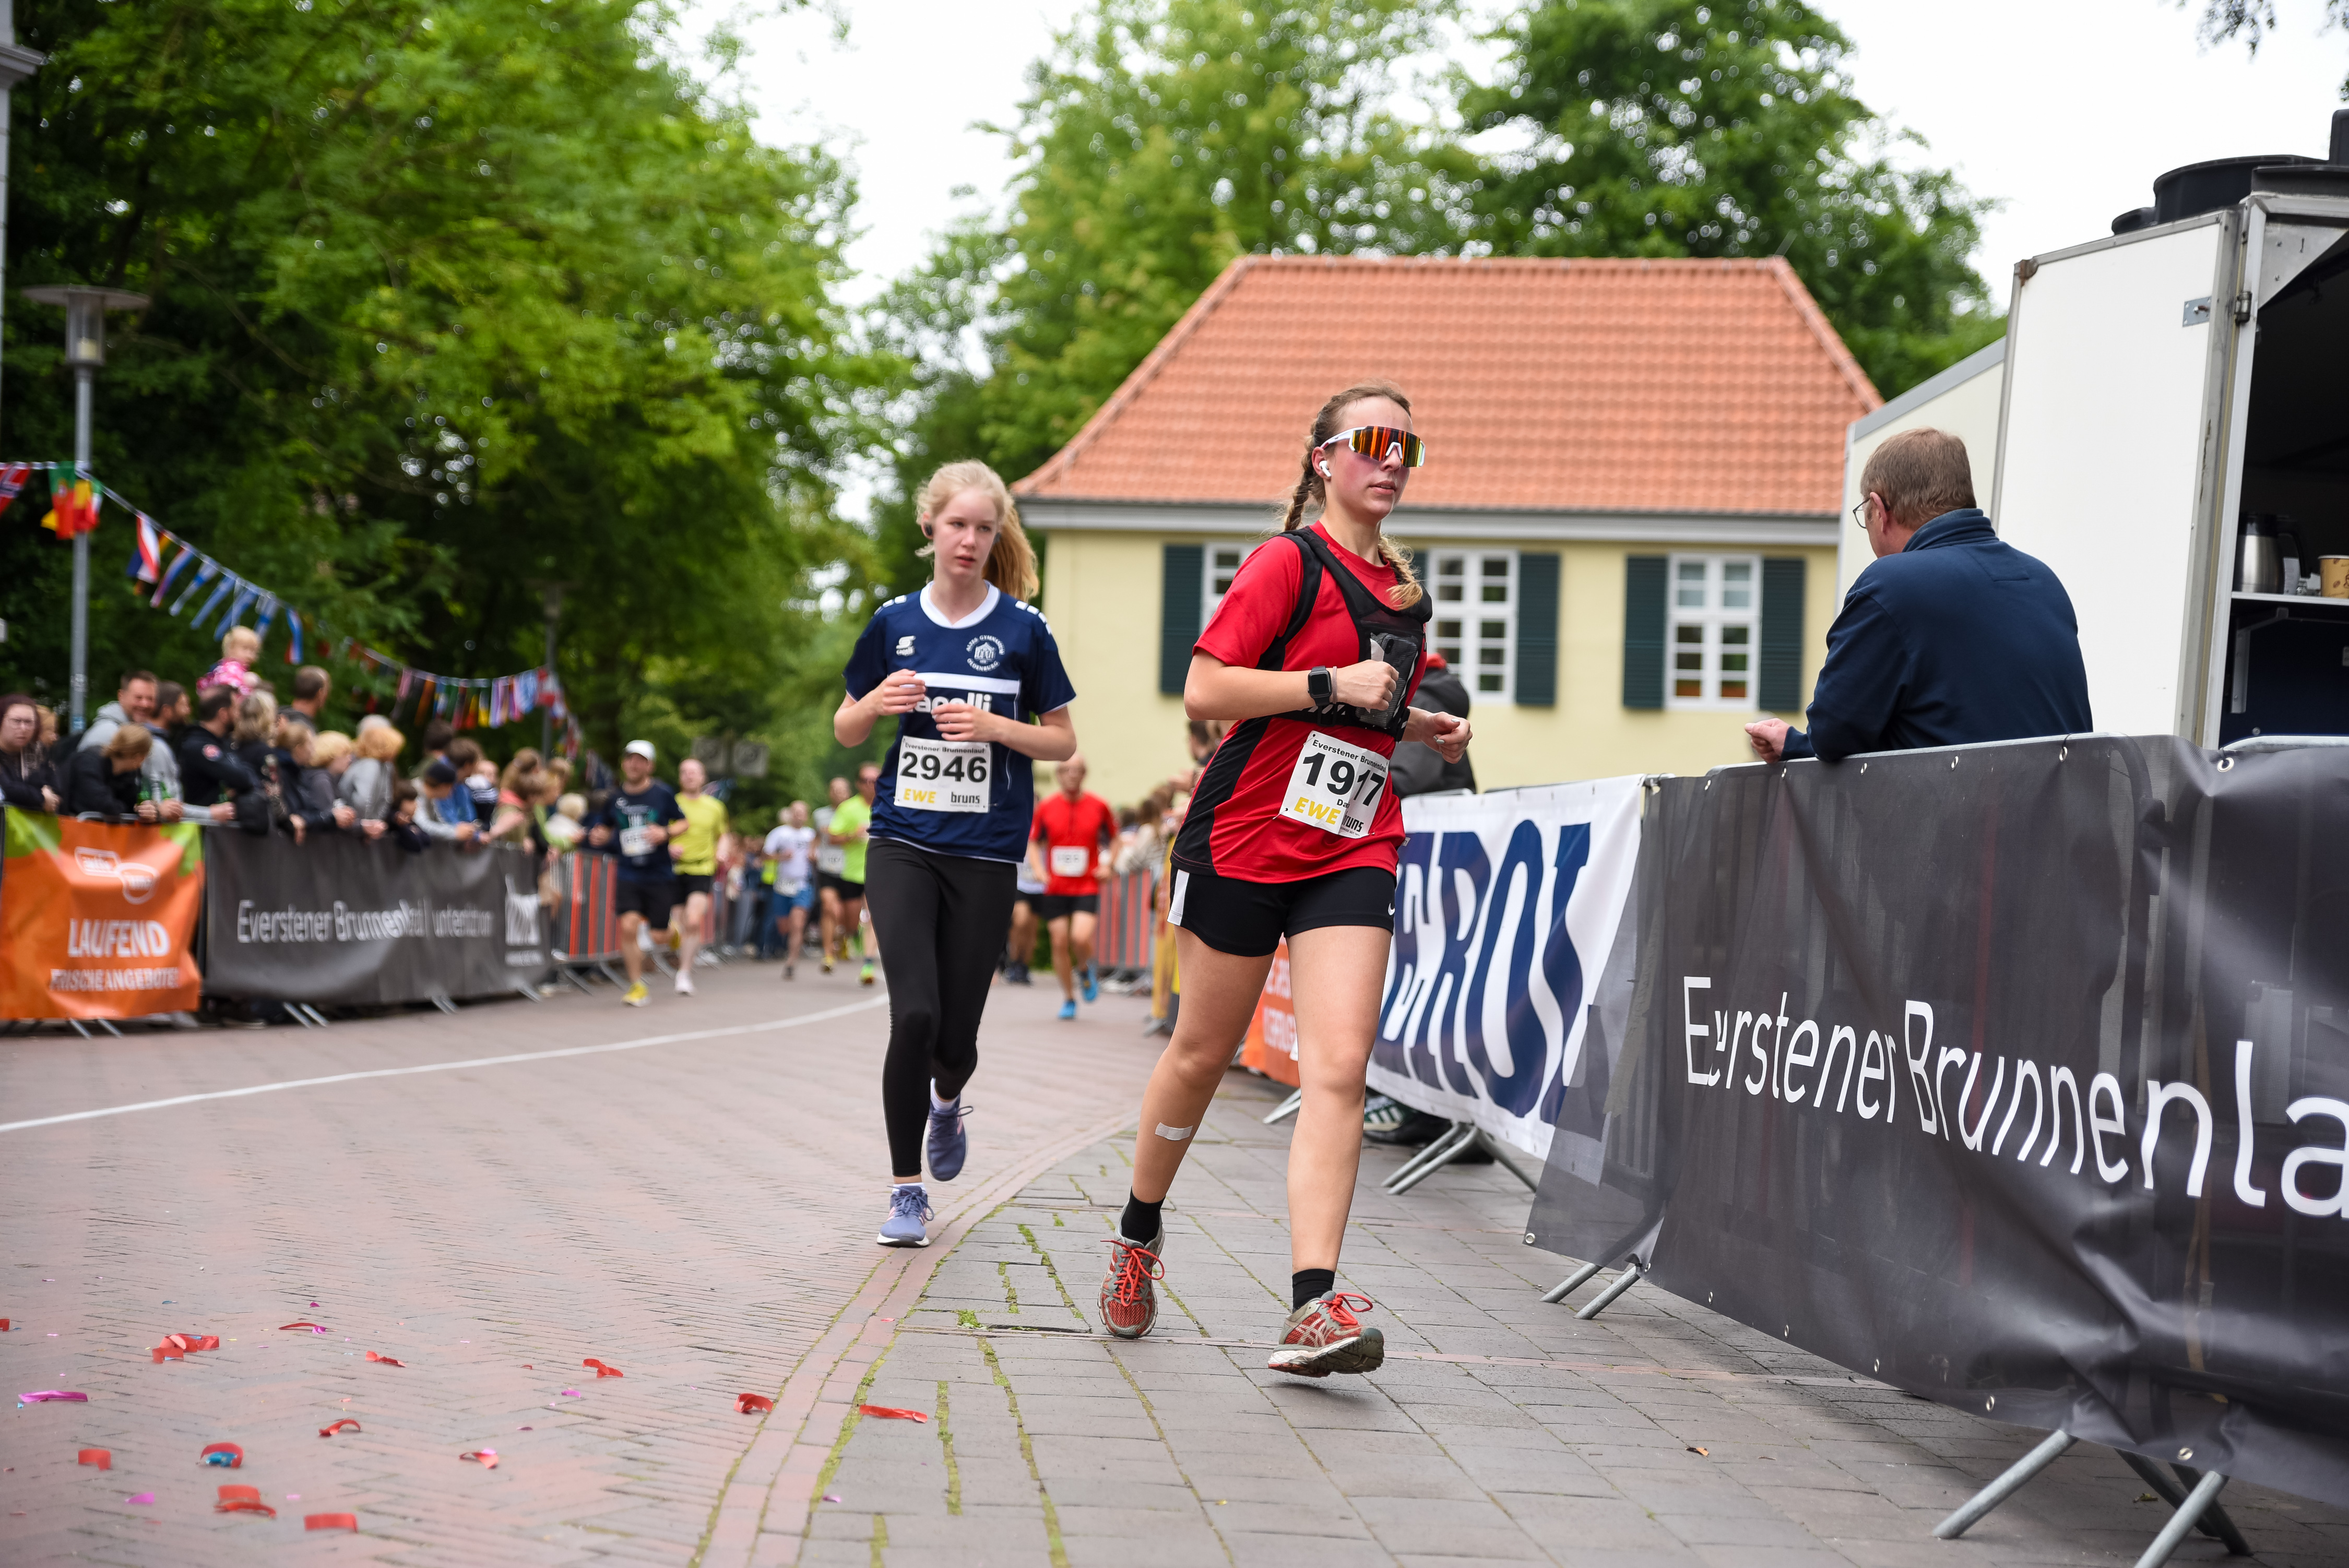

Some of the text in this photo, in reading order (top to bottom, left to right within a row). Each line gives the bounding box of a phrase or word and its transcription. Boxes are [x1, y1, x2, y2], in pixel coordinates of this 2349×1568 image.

[967, 658, 1000, 672] OLDENBURG
[905, 743, 940, 752] Everstener
[1312, 739, 1359, 761] Everstener
[899, 751, 987, 783] 2946
[1302, 752, 1385, 806] 1917
[903, 788, 980, 804] EWE bruns
[1294, 797, 1342, 825] EWE
[237, 899, 333, 943] Everstener
[68, 918, 170, 958] LAUFEND
